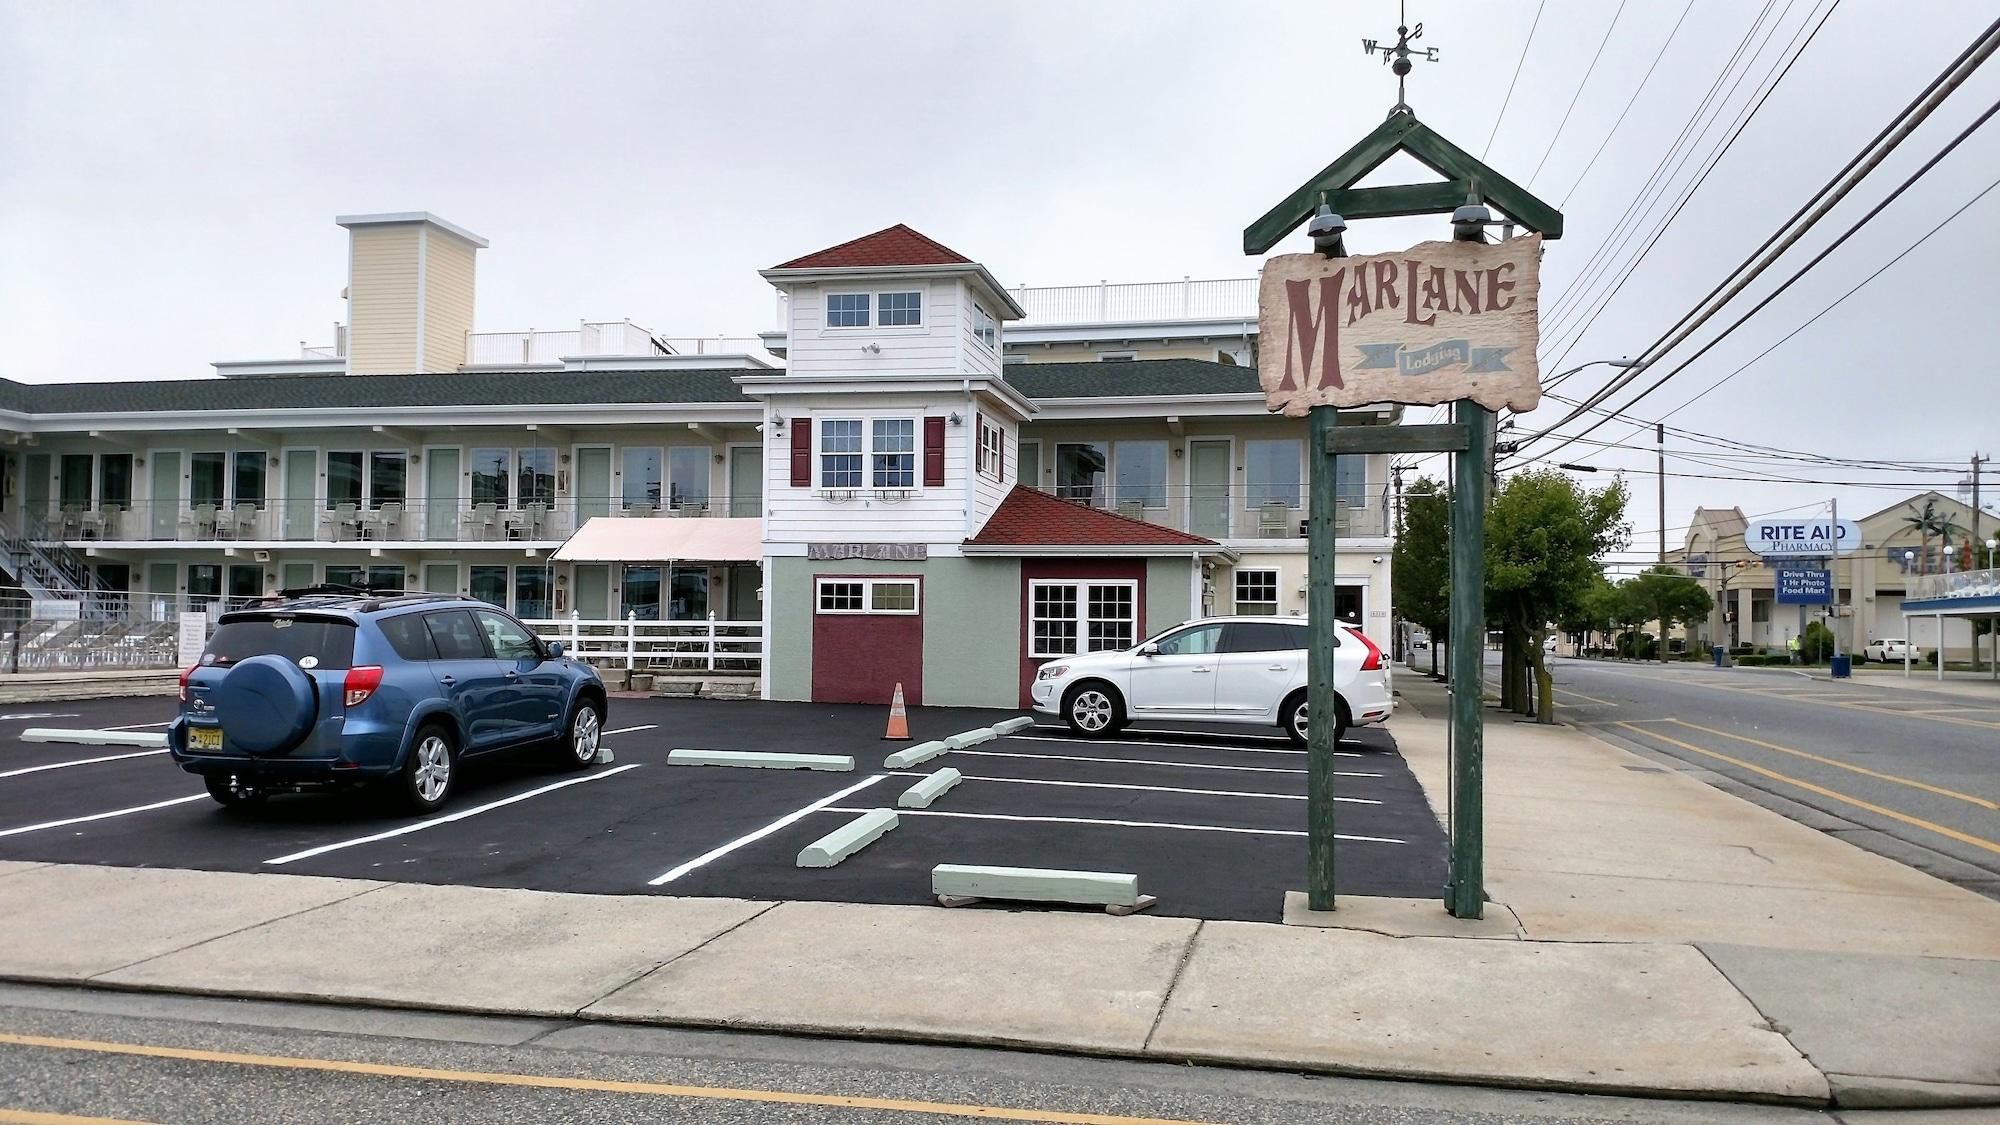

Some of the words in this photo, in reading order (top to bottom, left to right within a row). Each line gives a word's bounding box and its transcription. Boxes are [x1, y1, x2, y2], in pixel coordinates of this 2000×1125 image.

[1361, 38, 1378, 55] W
[1426, 47, 1439, 62] E
[1406, 346, 1461, 370] Lodging
[1761, 526, 1805, 540] RITE
[808, 543, 928, 559] MARLANE
[1773, 541, 1833, 552] PHARMACY
